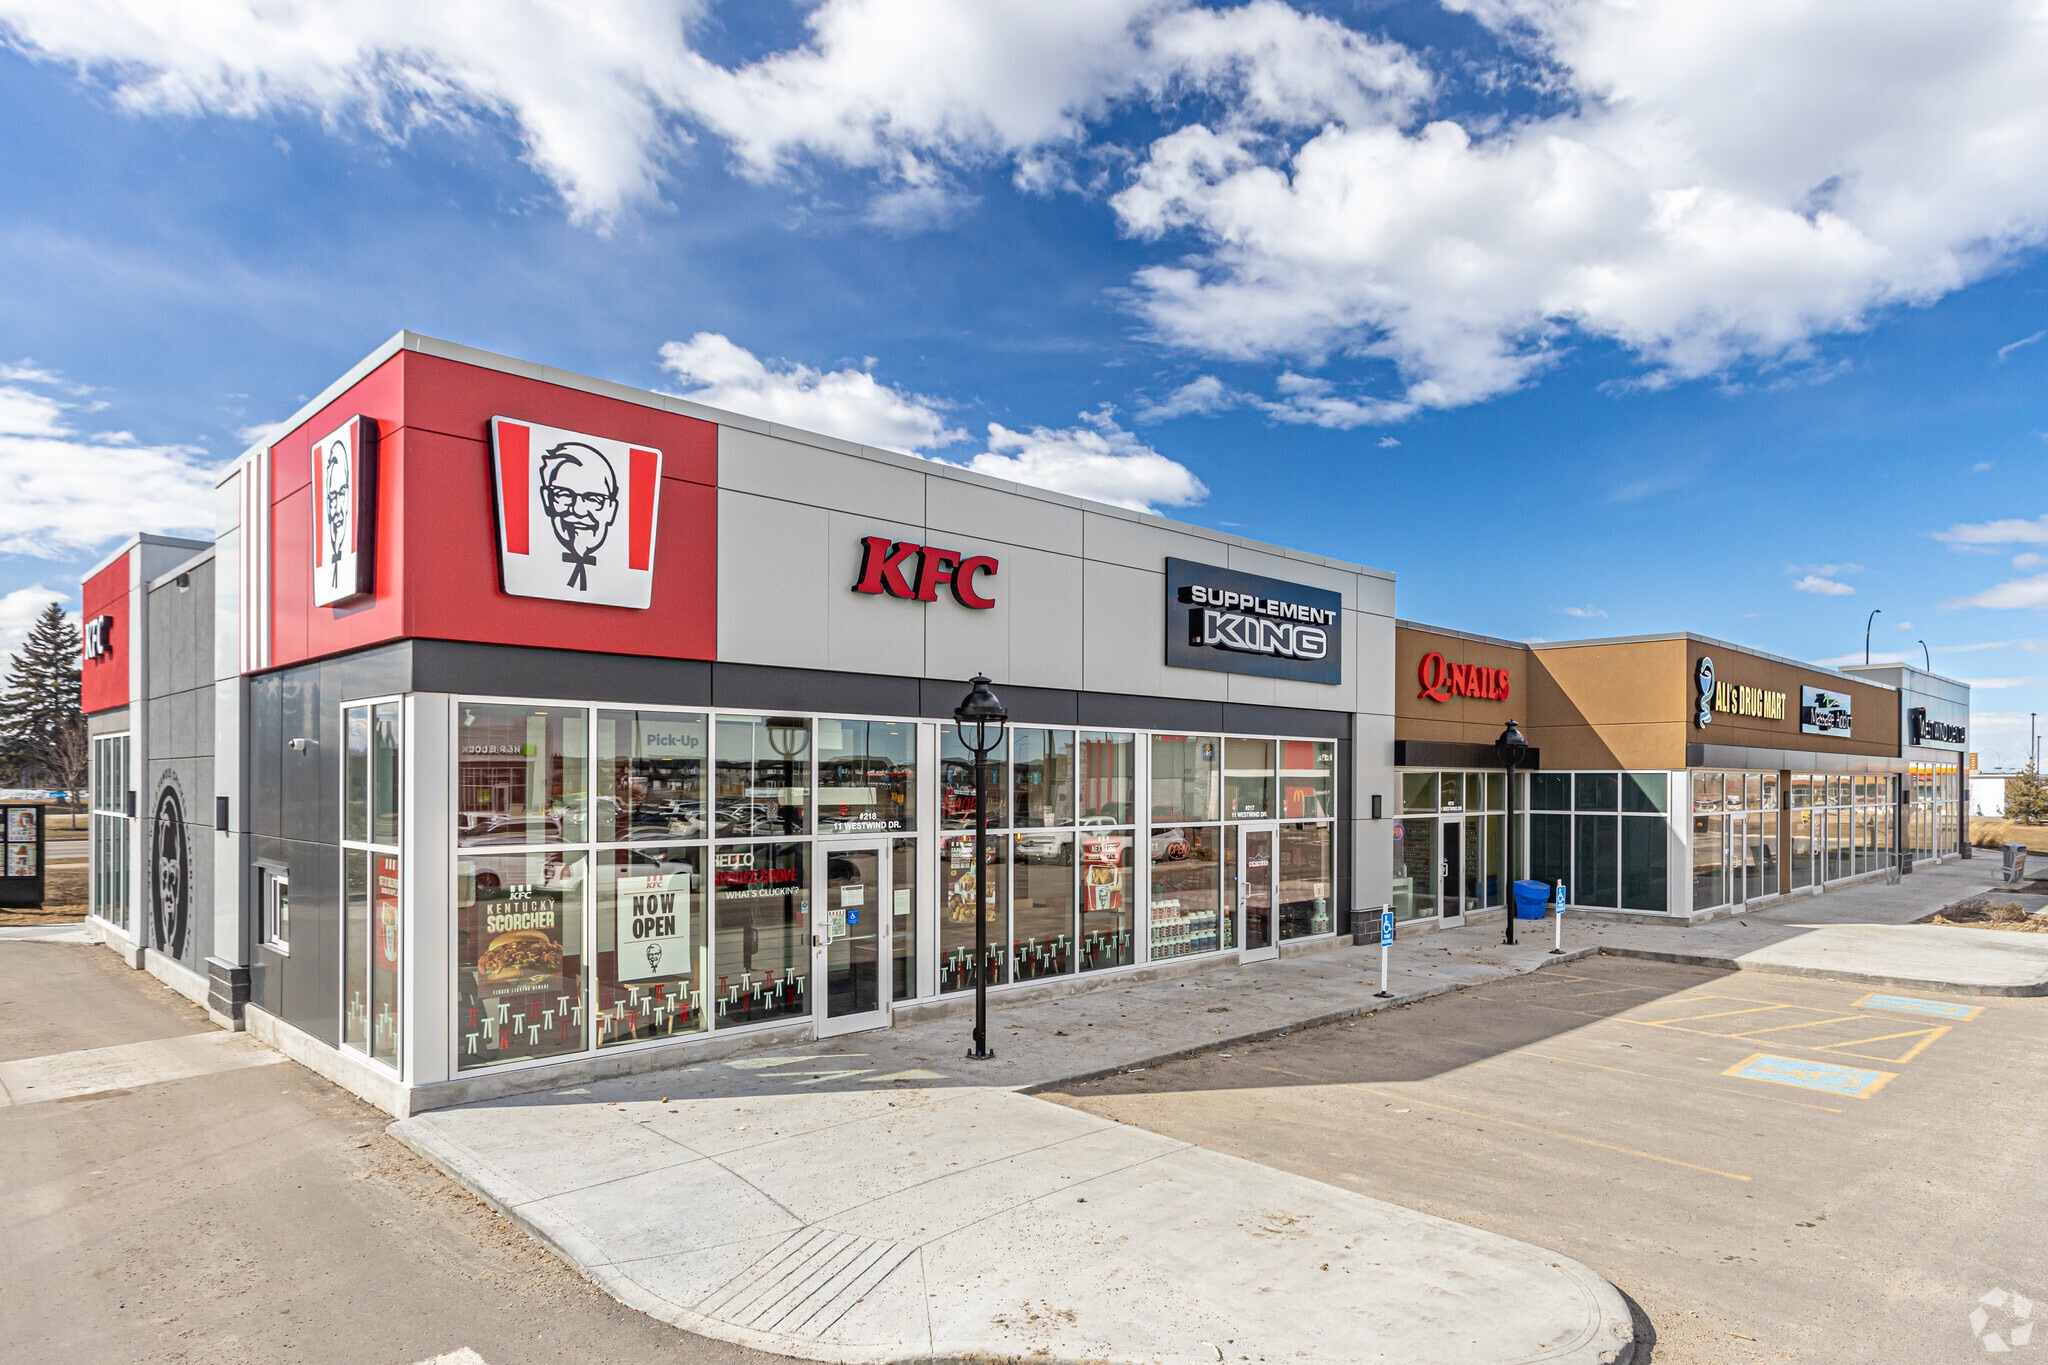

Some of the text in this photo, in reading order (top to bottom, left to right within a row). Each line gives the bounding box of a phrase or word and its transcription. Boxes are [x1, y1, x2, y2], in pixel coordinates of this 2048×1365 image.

[853, 536, 998, 610] KFC
[1190, 584, 1337, 626] SUPPLEMENT
[84, 615, 107, 660] KFC
[1203, 609, 1328, 660] KING
[1417, 651, 1510, 703] Q-NAILS
[1739, 685, 1763, 718] DRUG
[1763, 690, 1786, 720] MART
[647, 733, 700, 749] Pick-Up
[833, 820, 902, 830] 11 WESTWIND DR.
[859, 812, 877, 820] #218
[1169, 843, 1189, 855] OPEN
[646, 881, 663, 890] KFC
[714, 868, 797, 886] SPRUCE GROVE
[509, 891, 532, 901] KFC
[725, 889, 758, 900] WHAT'S
[487, 899, 555, 915] KENTUCKY
[632, 893, 675, 917] NOW
[487, 911, 555, 934] SCORCHER
[632, 915, 675, 940] OPEN
